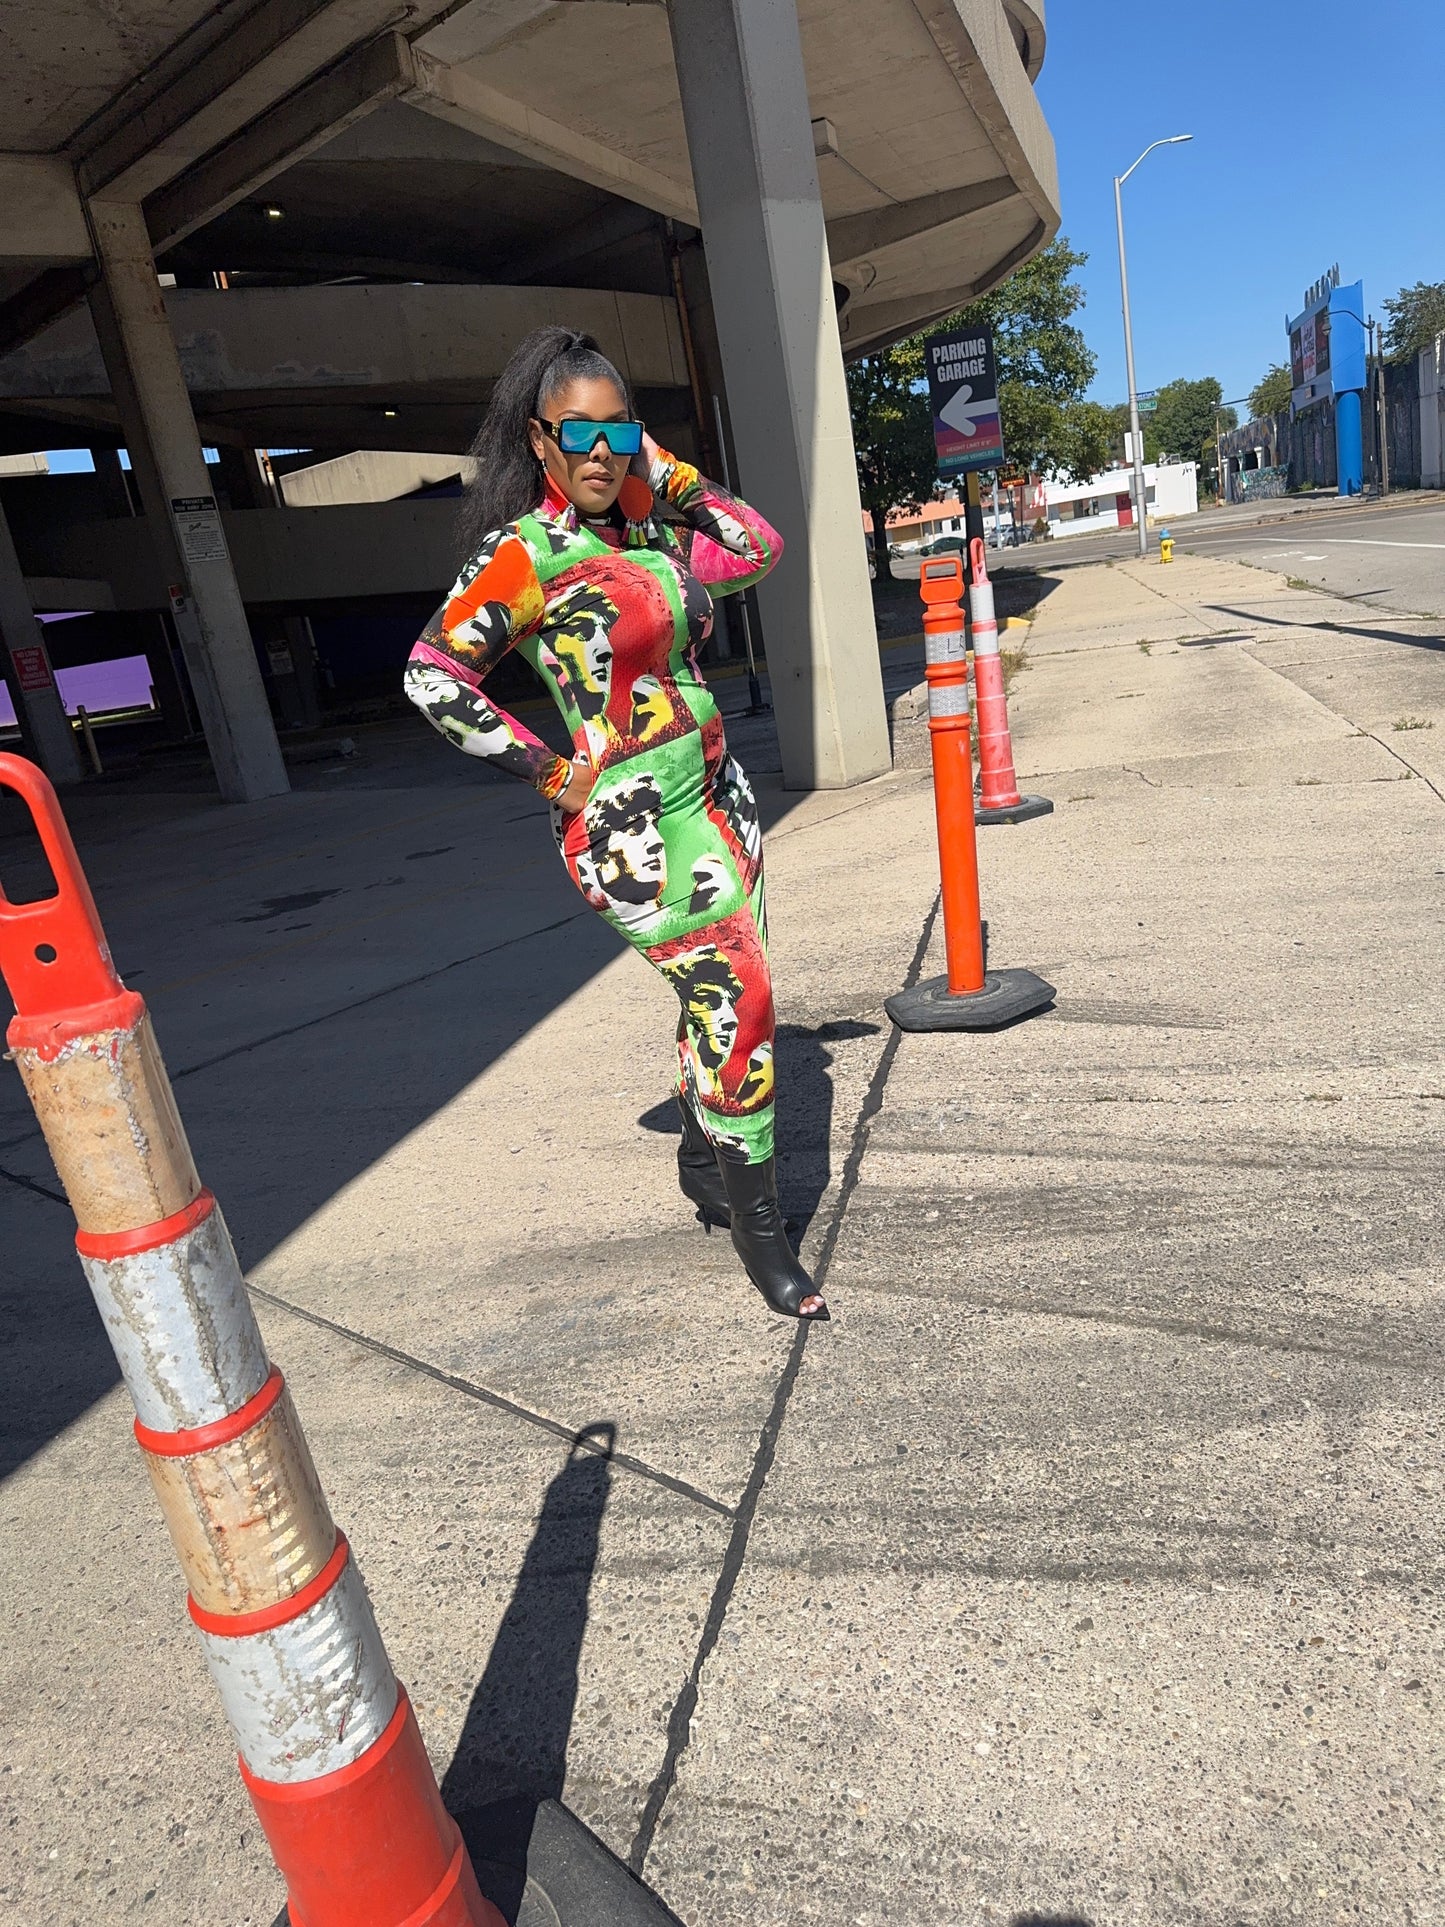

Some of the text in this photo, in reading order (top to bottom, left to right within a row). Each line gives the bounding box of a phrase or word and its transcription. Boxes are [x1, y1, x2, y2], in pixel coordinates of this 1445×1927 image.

[932, 338, 987, 364] PARKING
[937, 358, 986, 383] GARAGE
[954, 455, 969, 463] LONG
[970, 450, 995, 459] VEHICLES
